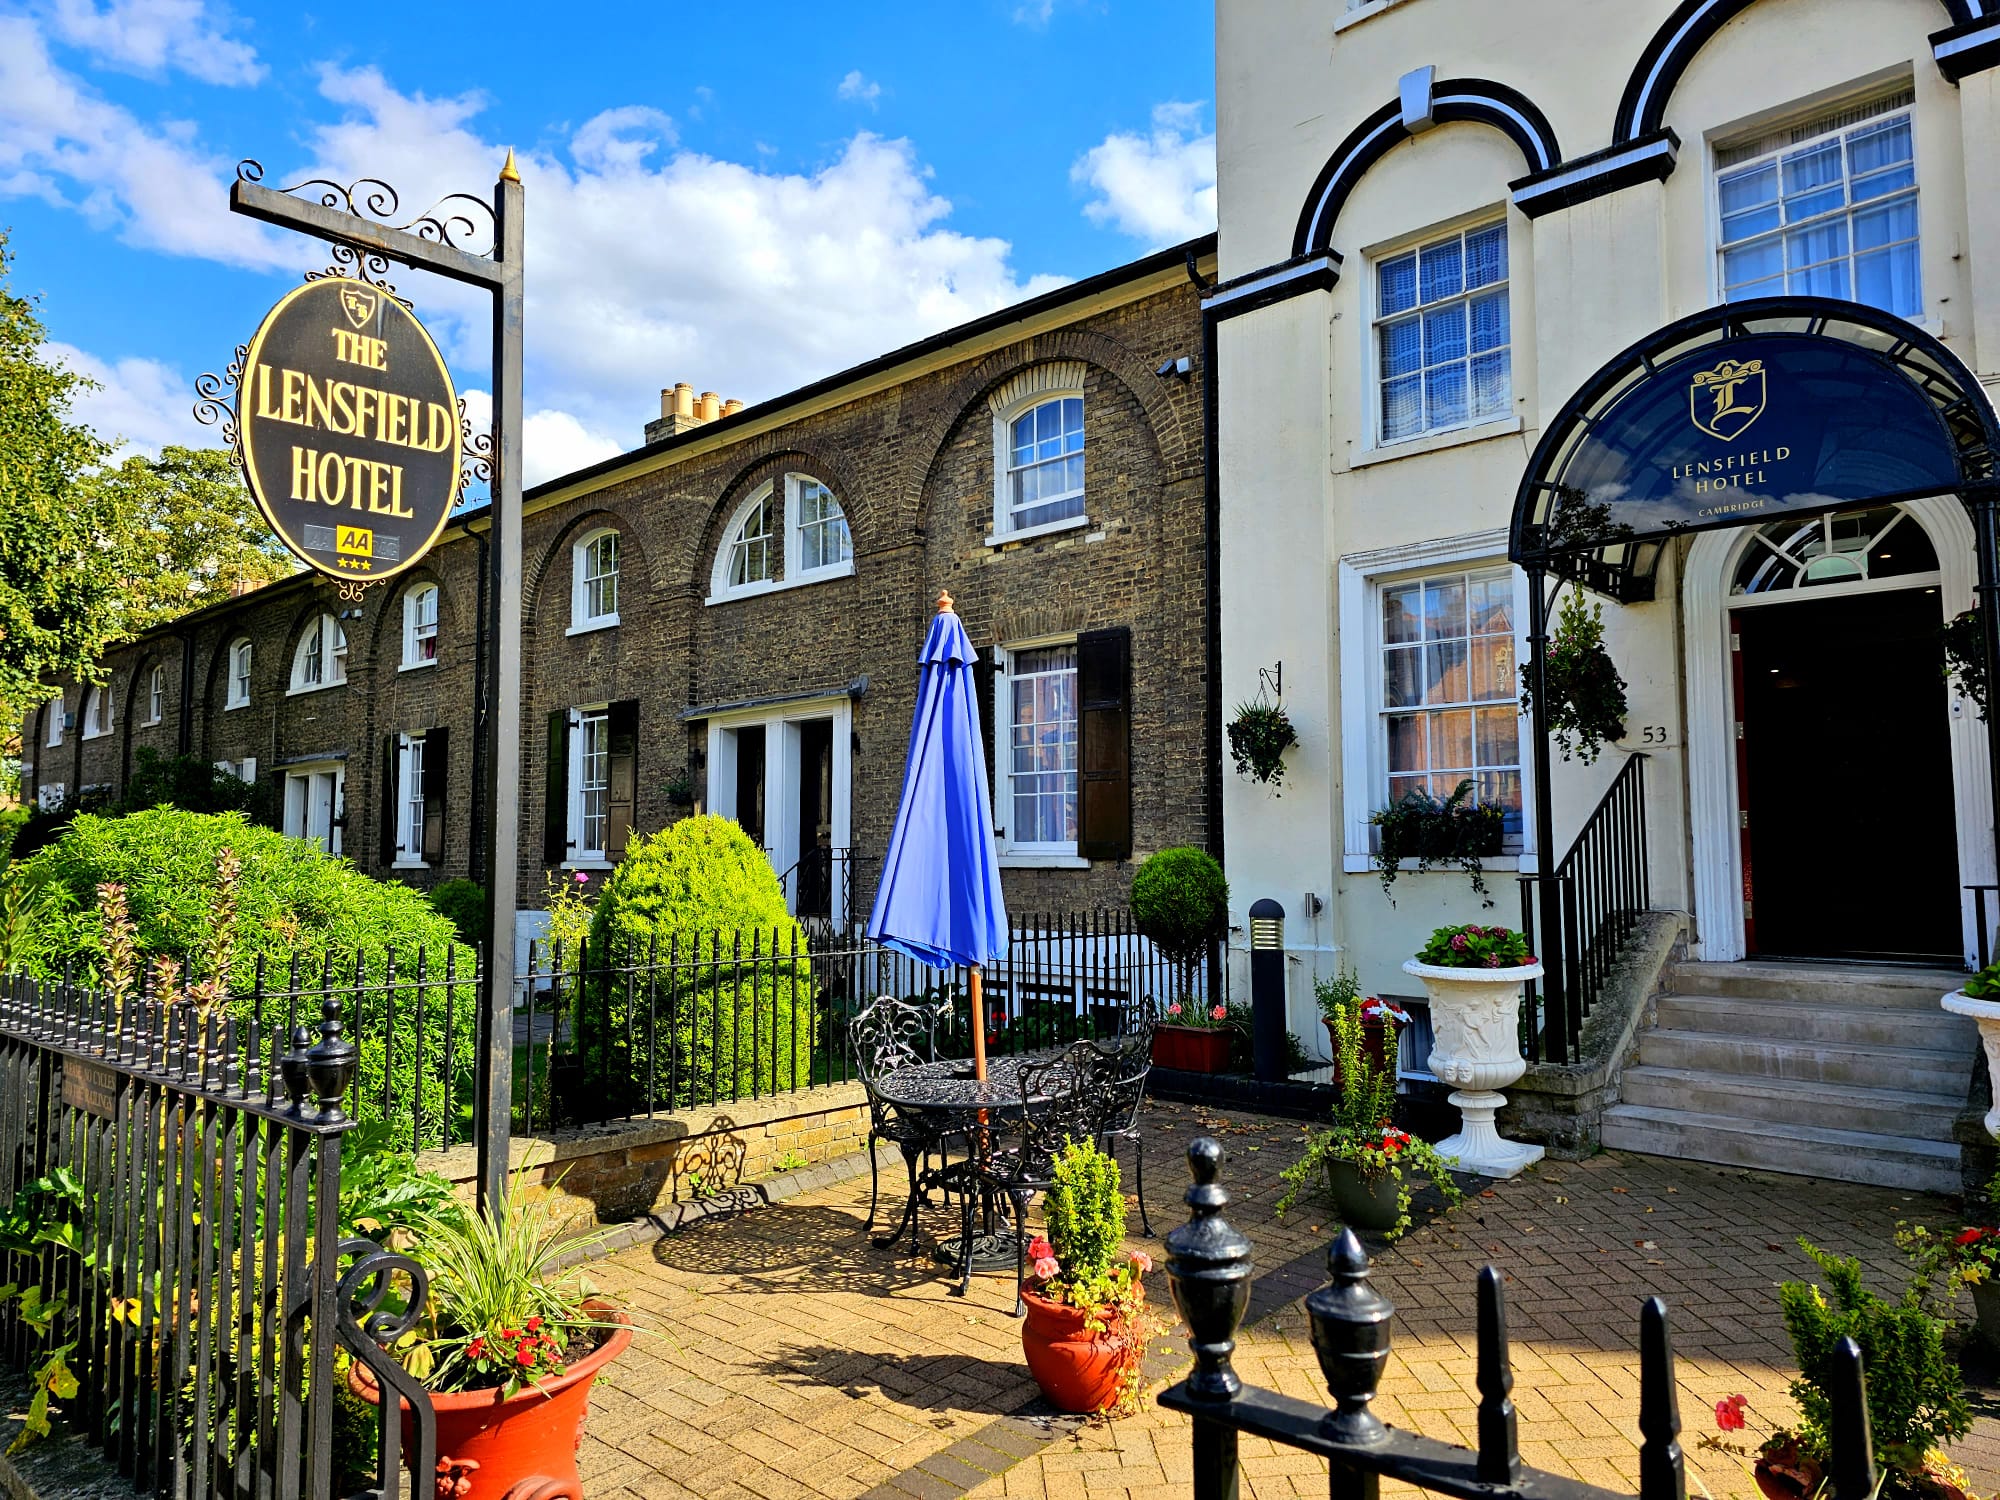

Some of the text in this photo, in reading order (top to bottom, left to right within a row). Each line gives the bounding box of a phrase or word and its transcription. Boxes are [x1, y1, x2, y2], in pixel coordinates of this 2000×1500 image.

[332, 328, 388, 371] THE
[256, 363, 453, 453] LENSFIELD
[1672, 446, 1791, 479] LENSFIELD
[291, 446, 413, 518] HOTEL
[1696, 470, 1767, 494] HOTEL
[1698, 499, 1765, 517] CAMBRIDGE
[341, 530, 369, 550] AA
[1642, 725, 1667, 743] 53
[93, 1069, 115, 1090] CYCLES
